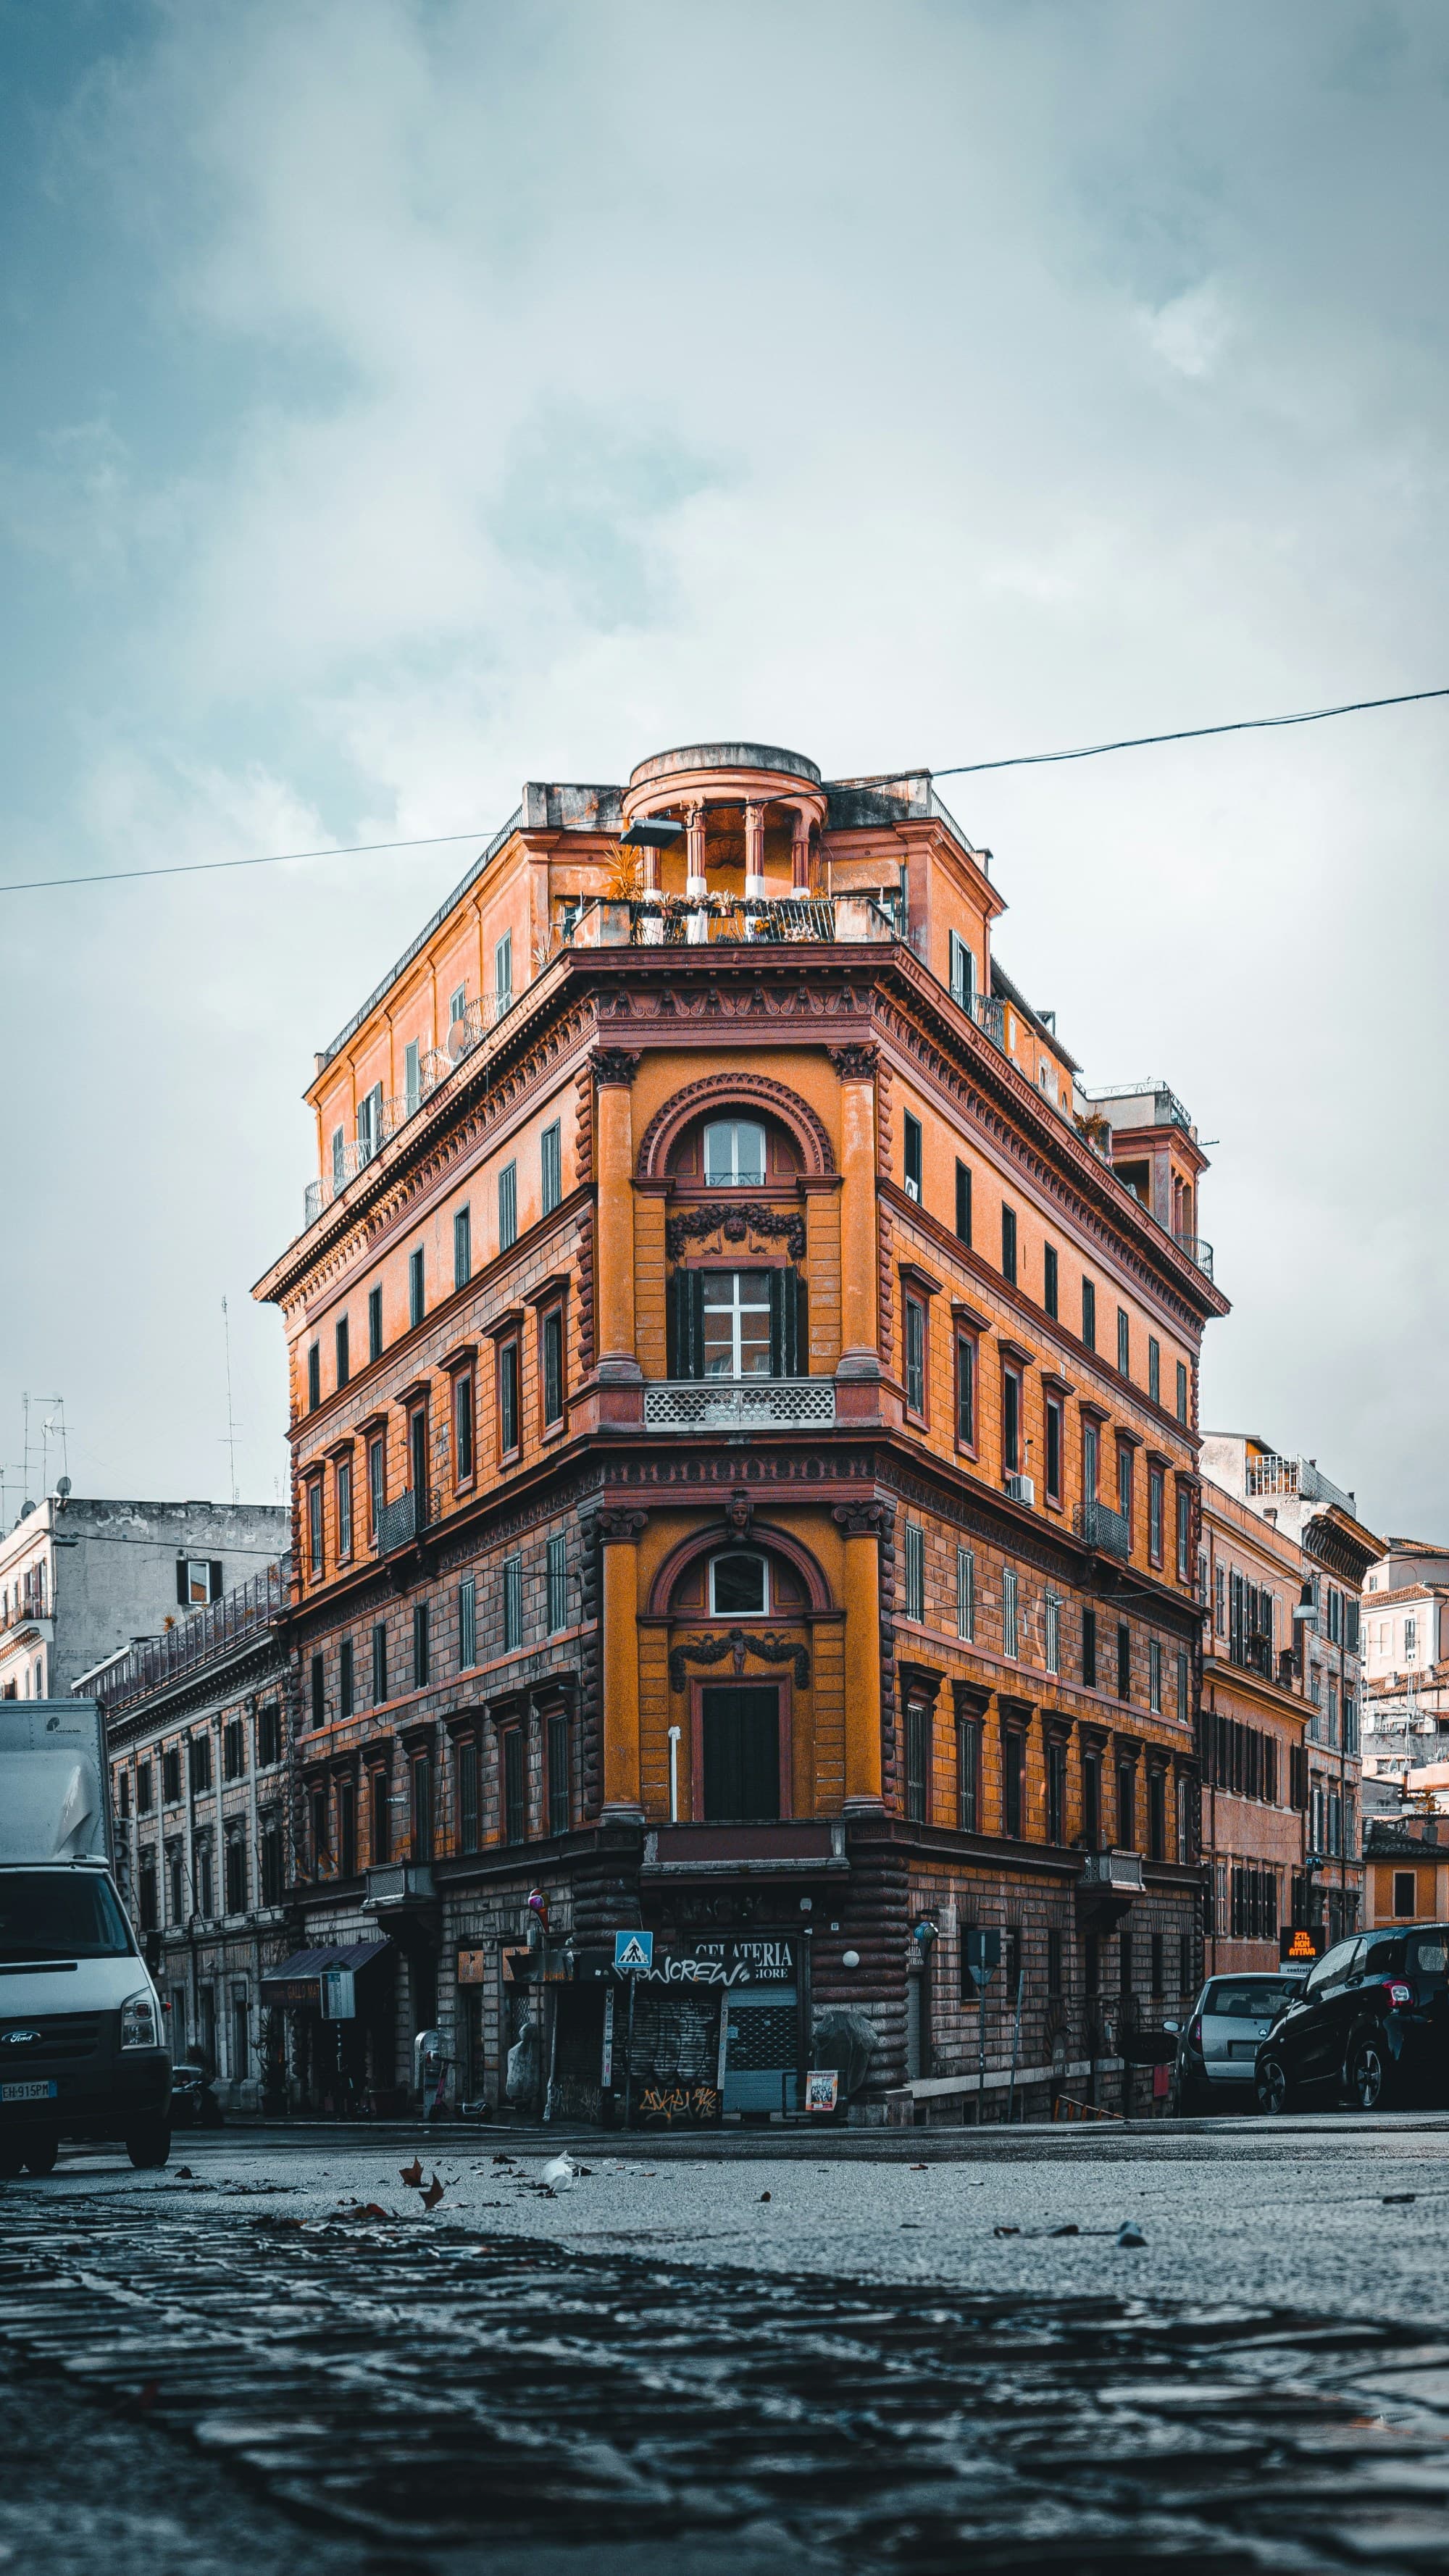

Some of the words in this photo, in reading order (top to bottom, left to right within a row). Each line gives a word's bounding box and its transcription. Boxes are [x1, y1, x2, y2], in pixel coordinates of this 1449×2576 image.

[1294, 1931, 1310, 1940] ZTL
[1289, 1947, 1316, 1956] ATTIVA
[10, 2033, 33, 2043] Ford
